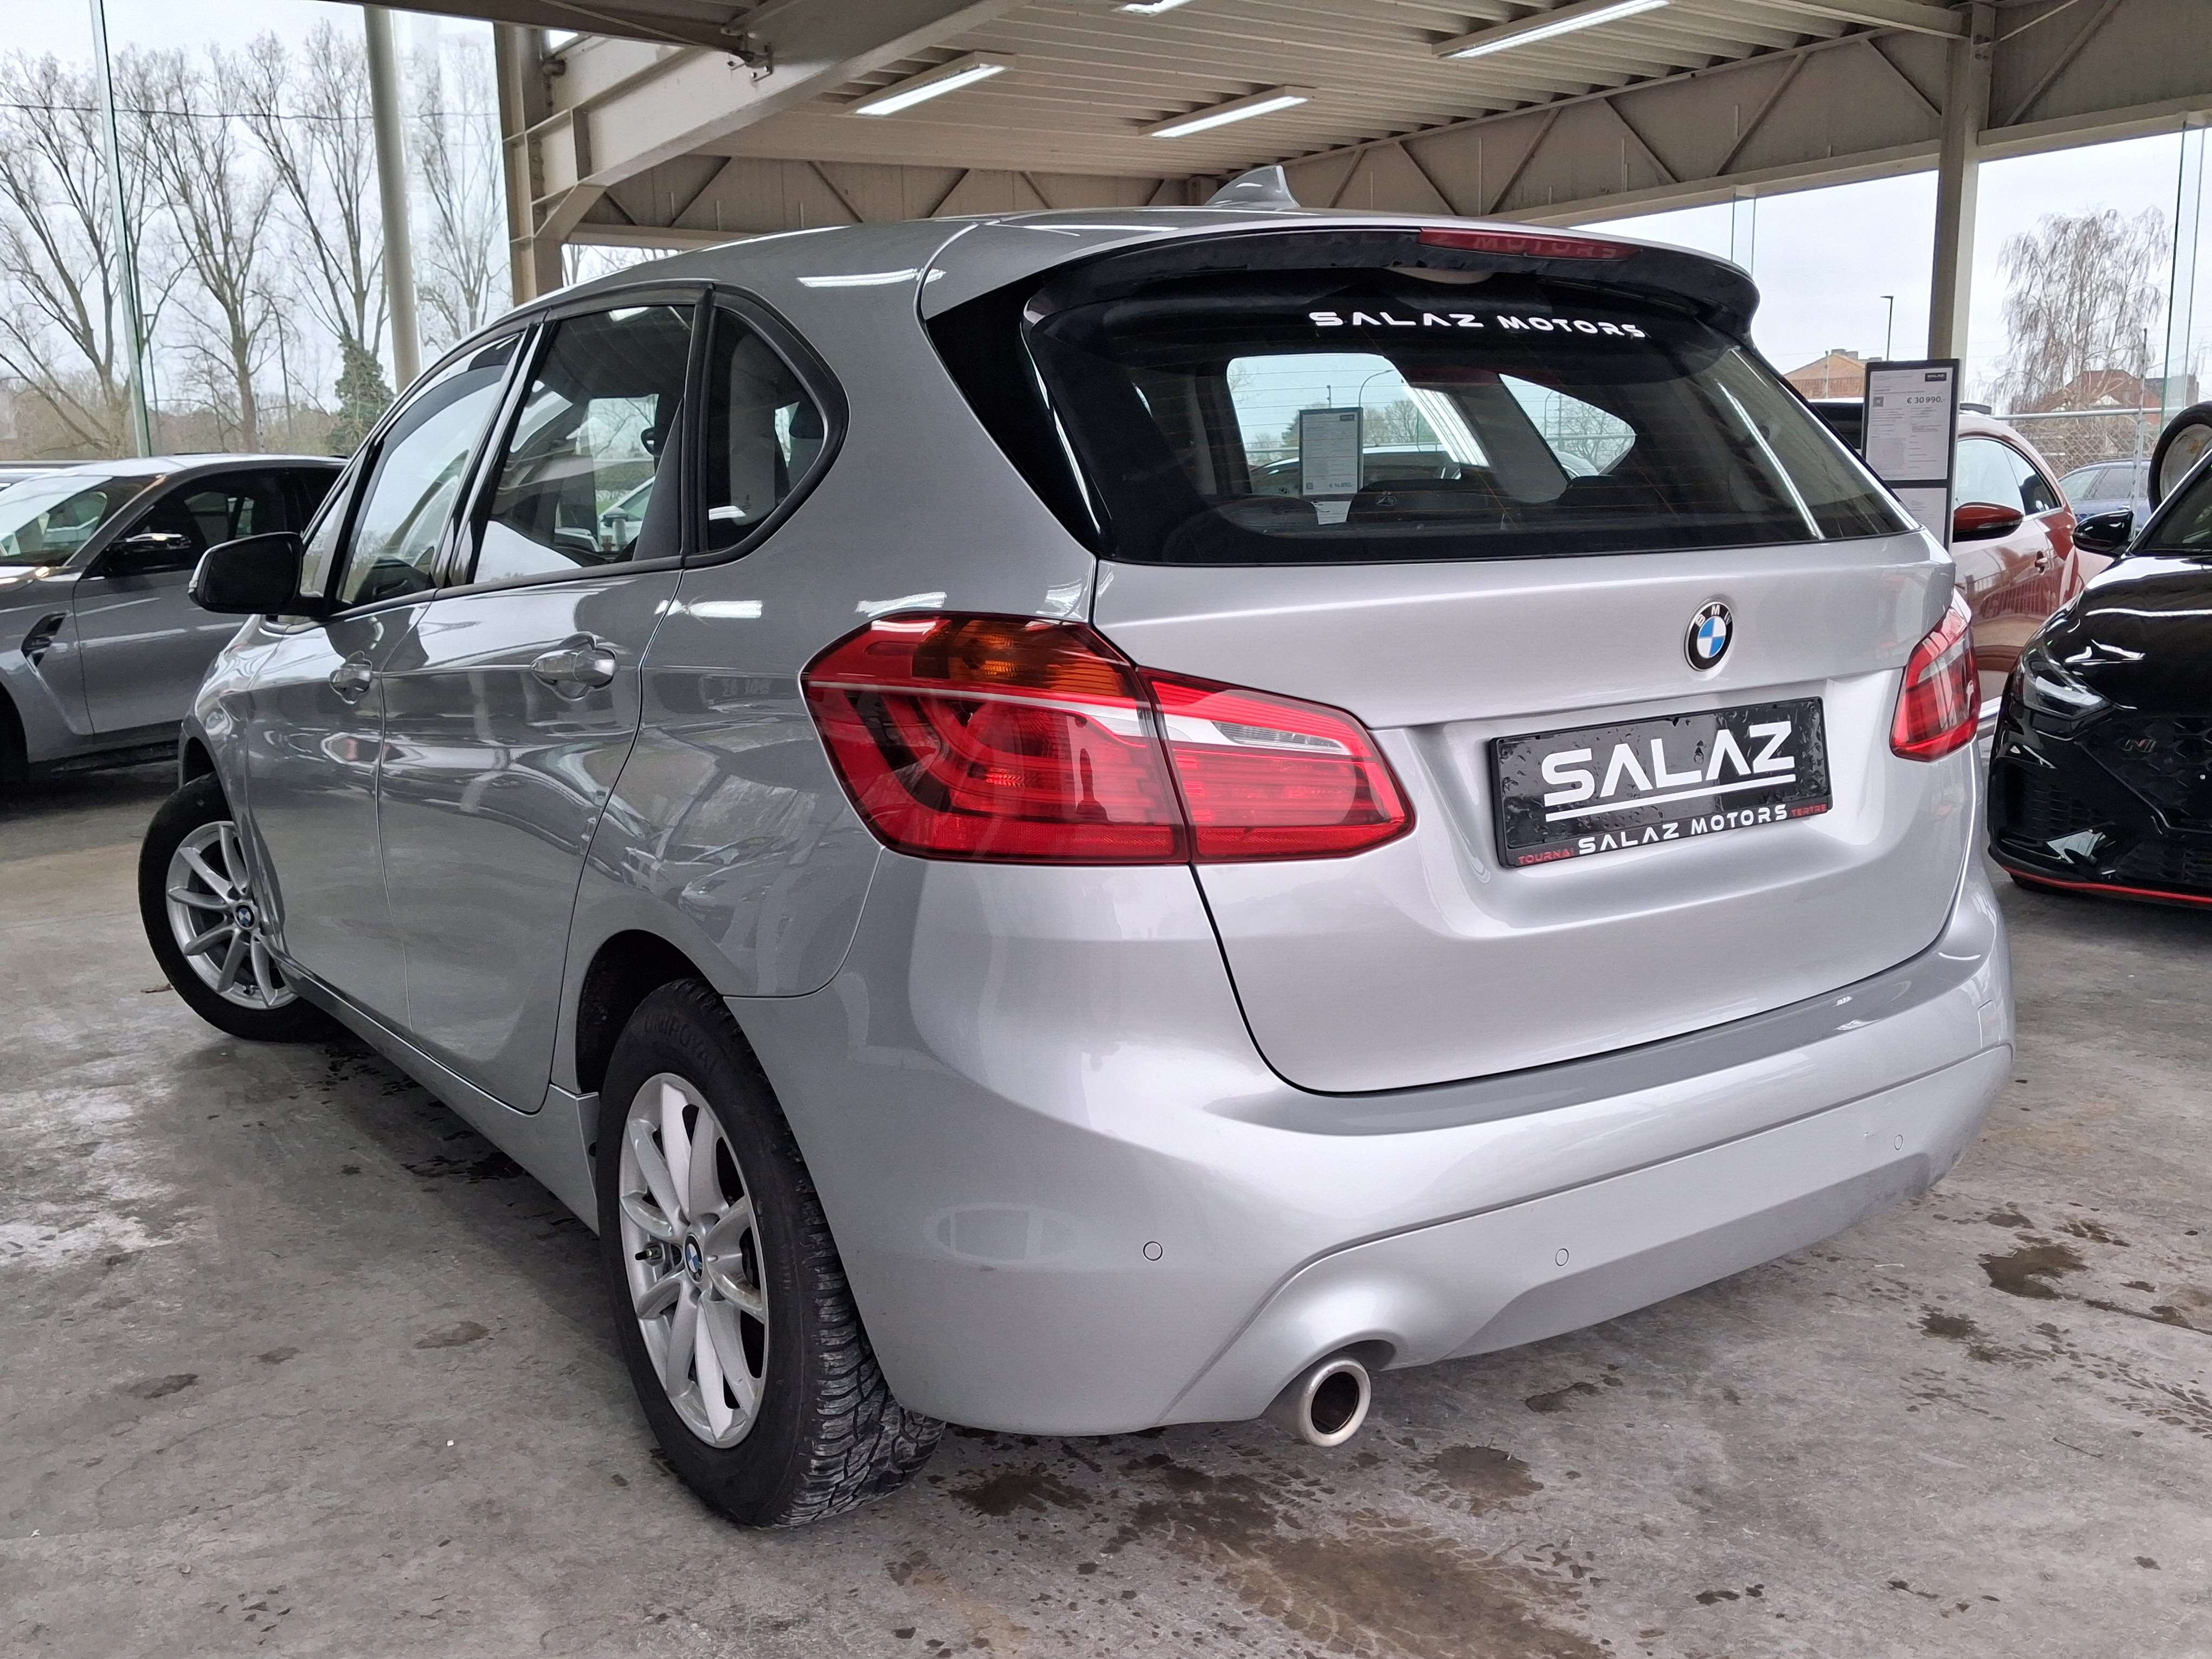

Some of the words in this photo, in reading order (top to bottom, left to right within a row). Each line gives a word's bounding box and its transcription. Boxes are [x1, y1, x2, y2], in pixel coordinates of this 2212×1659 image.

[1309, 311, 1484, 327] SALAZ
[1496, 314, 1645, 338] MOTORS
[1695, 604, 1732, 628] BMW
[1541, 721, 1795, 807] SALAZ
[1578, 822, 1679, 854] SALAZ
[1691, 804, 1787, 835] MOTORS
[1791, 803, 1827, 816] TERTRE
